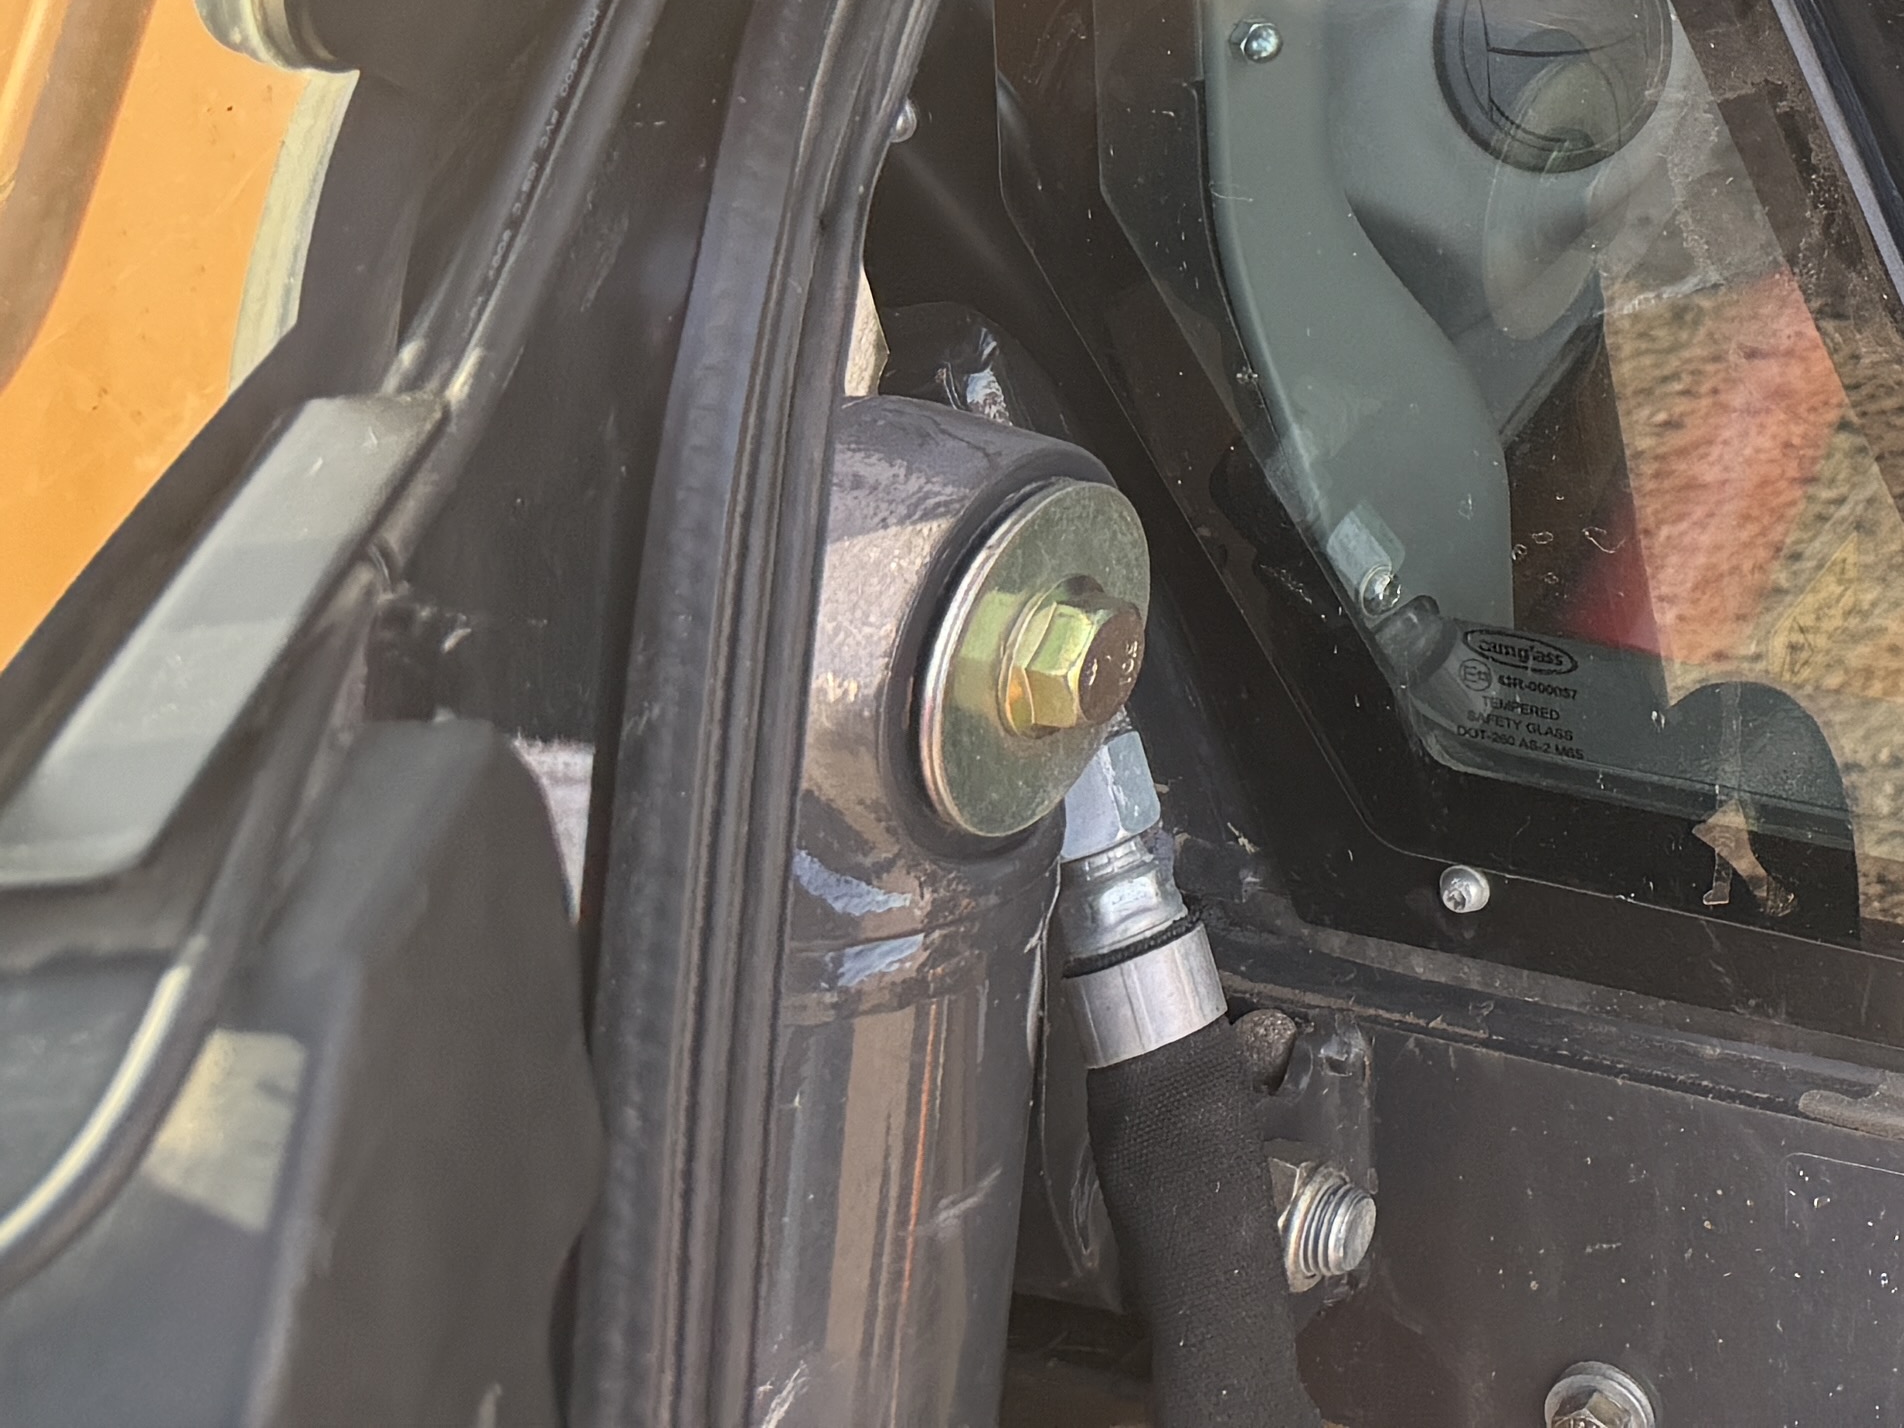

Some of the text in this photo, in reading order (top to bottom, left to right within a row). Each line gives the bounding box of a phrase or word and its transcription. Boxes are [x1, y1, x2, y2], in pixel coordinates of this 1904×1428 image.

[1482, 695, 1561, 722] TEMPERED
[1467, 710, 1574, 742] SAFETY GLASS
